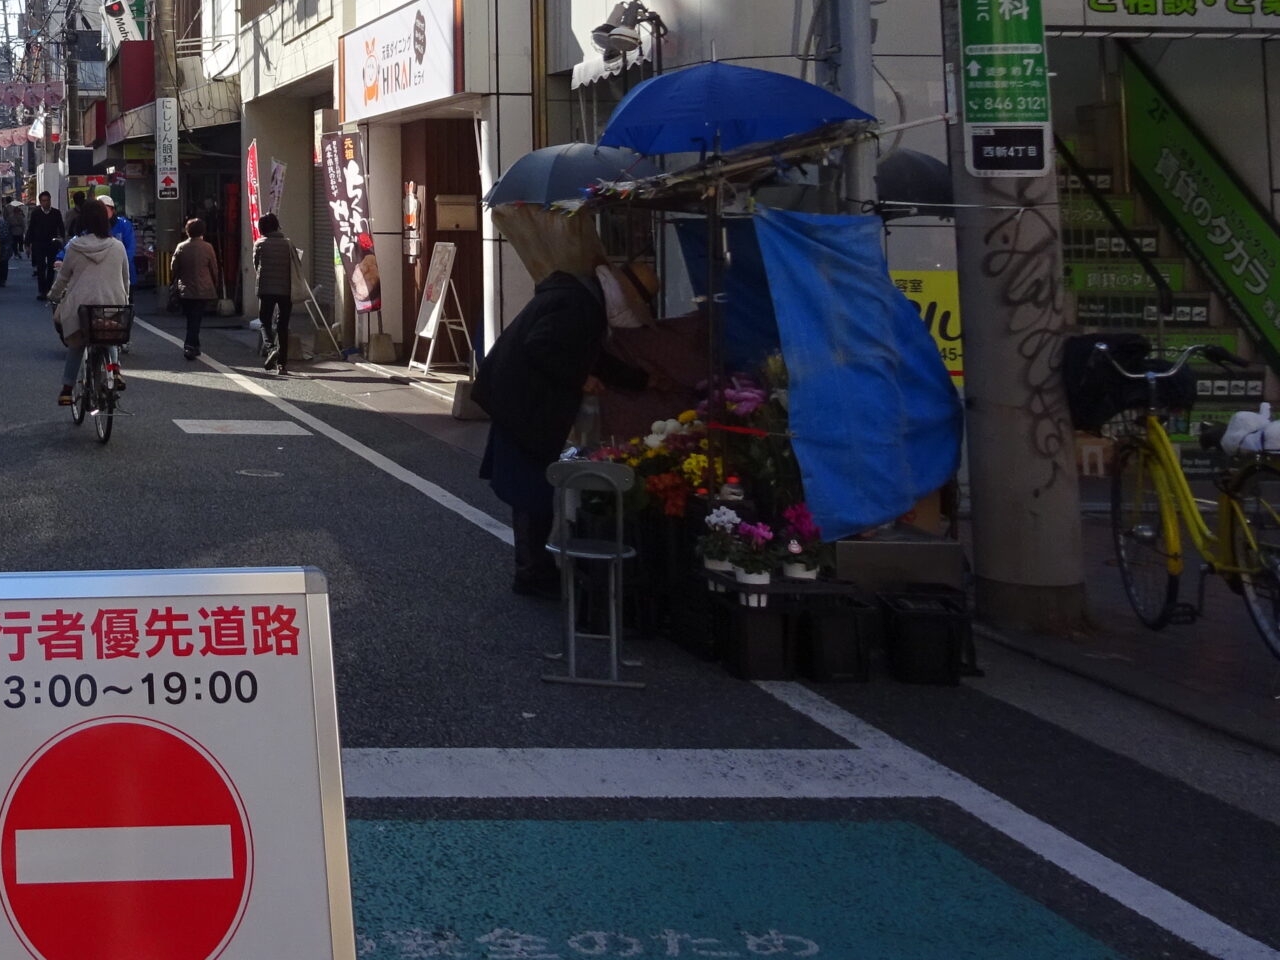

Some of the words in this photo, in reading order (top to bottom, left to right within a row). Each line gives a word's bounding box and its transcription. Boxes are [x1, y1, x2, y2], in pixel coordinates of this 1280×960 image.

[382, 57, 412, 96] HIRAI
[984, 97, 1013, 110] 846
[1017, 96, 1046, 110] 3121
[162, 99, 173, 166] にしじん眼科
[982, 145, 1038, 158] 西新4丁目
